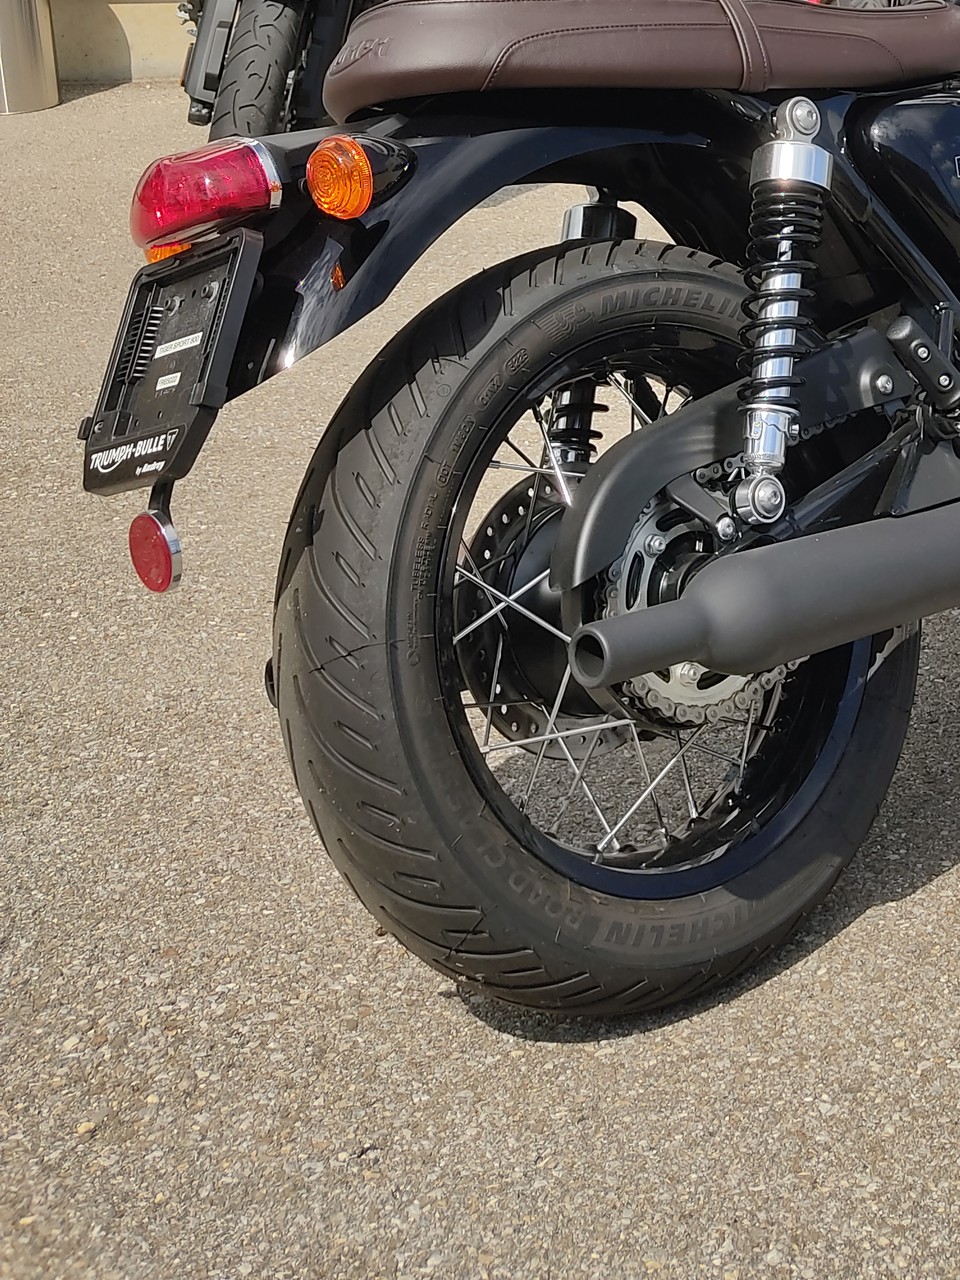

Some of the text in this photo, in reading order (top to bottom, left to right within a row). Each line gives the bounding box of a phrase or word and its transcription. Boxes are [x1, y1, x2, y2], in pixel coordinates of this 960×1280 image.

[601, 286, 751, 322] MICHELIN
[411, 536, 425, 592] TUBELESS
[421, 493, 437, 529] RADIAL
[604, 901, 755, 950] ICHELIN
